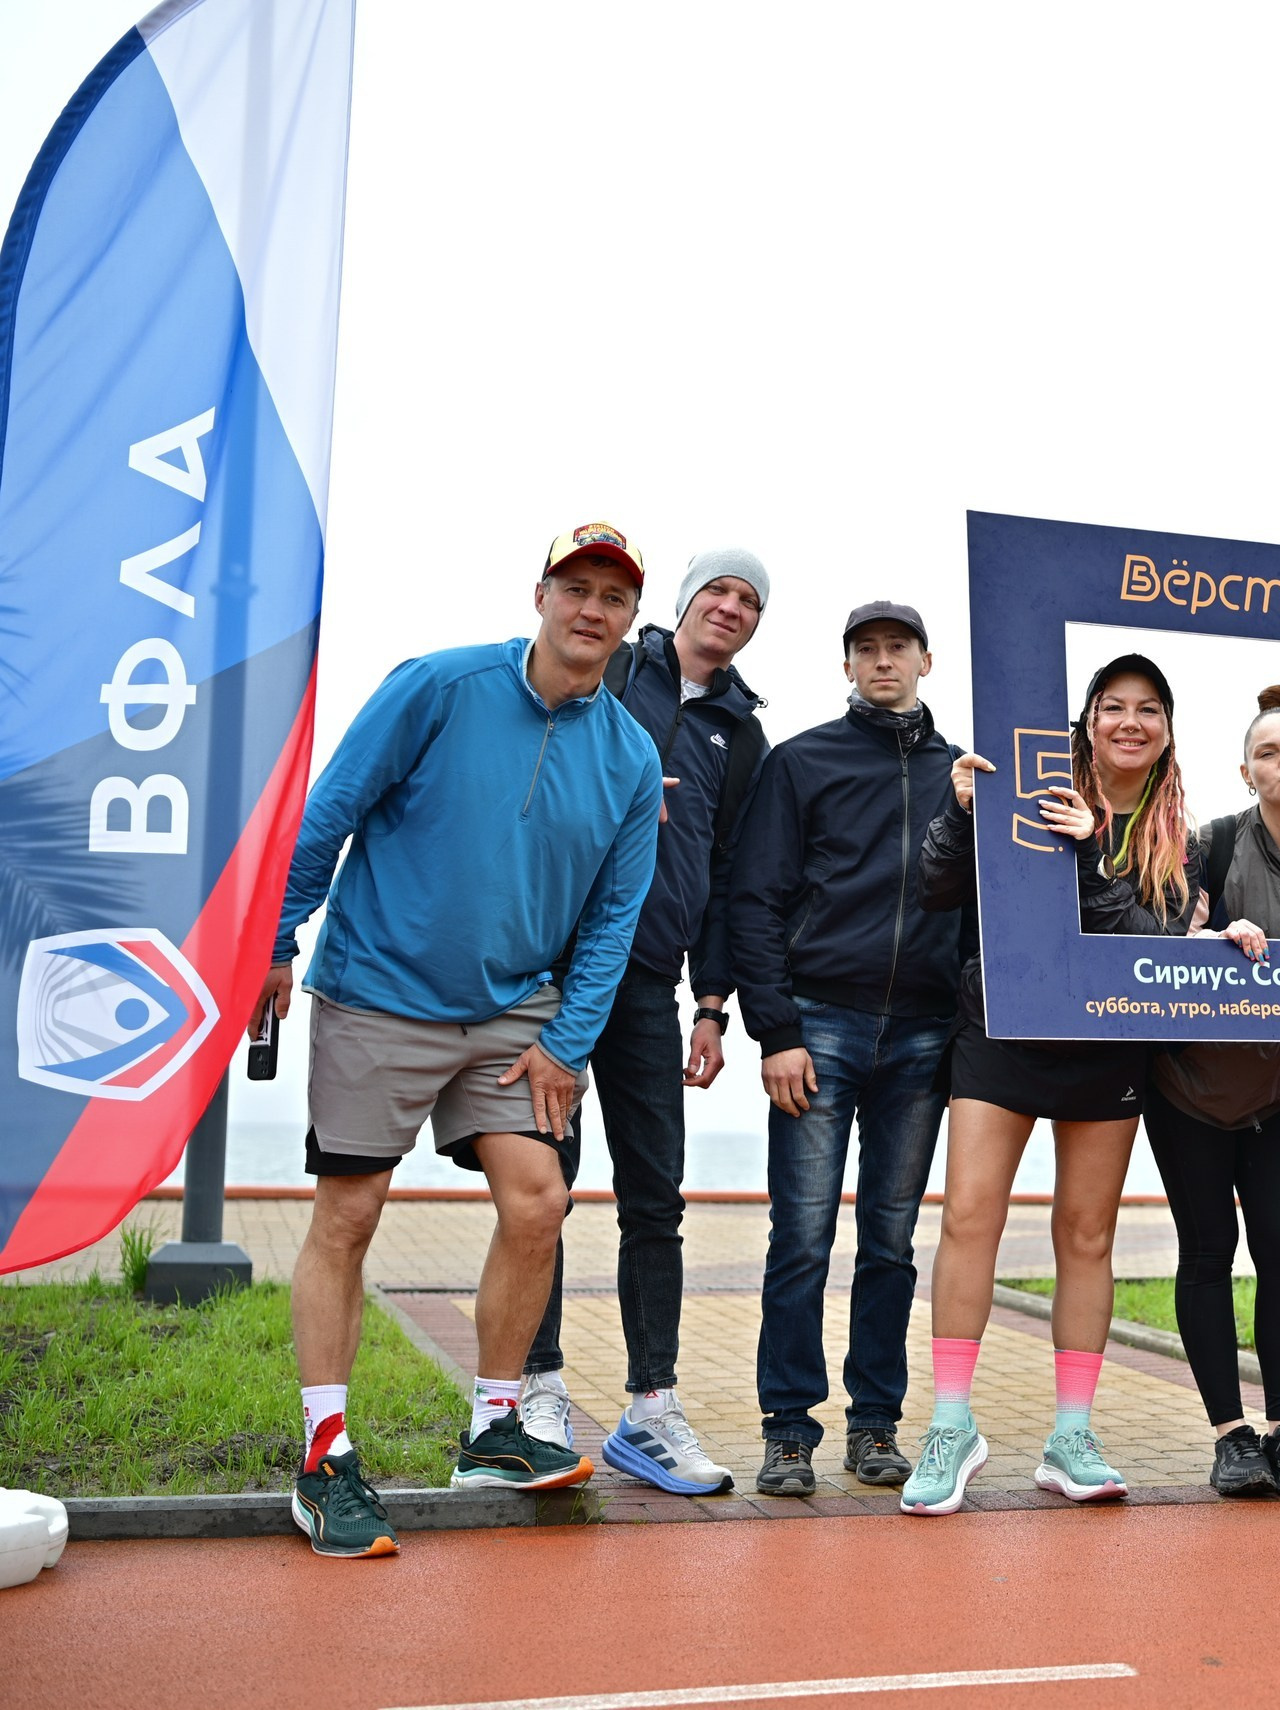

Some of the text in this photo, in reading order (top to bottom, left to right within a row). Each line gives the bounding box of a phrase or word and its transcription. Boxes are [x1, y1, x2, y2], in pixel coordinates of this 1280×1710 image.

[89, 406, 216, 854] ВФЛА
[1133, 957, 1246, 990] Сириус.
[1085, 997, 1165, 1017] суббота,
[1168, 1001, 1216, 1018] утро,
